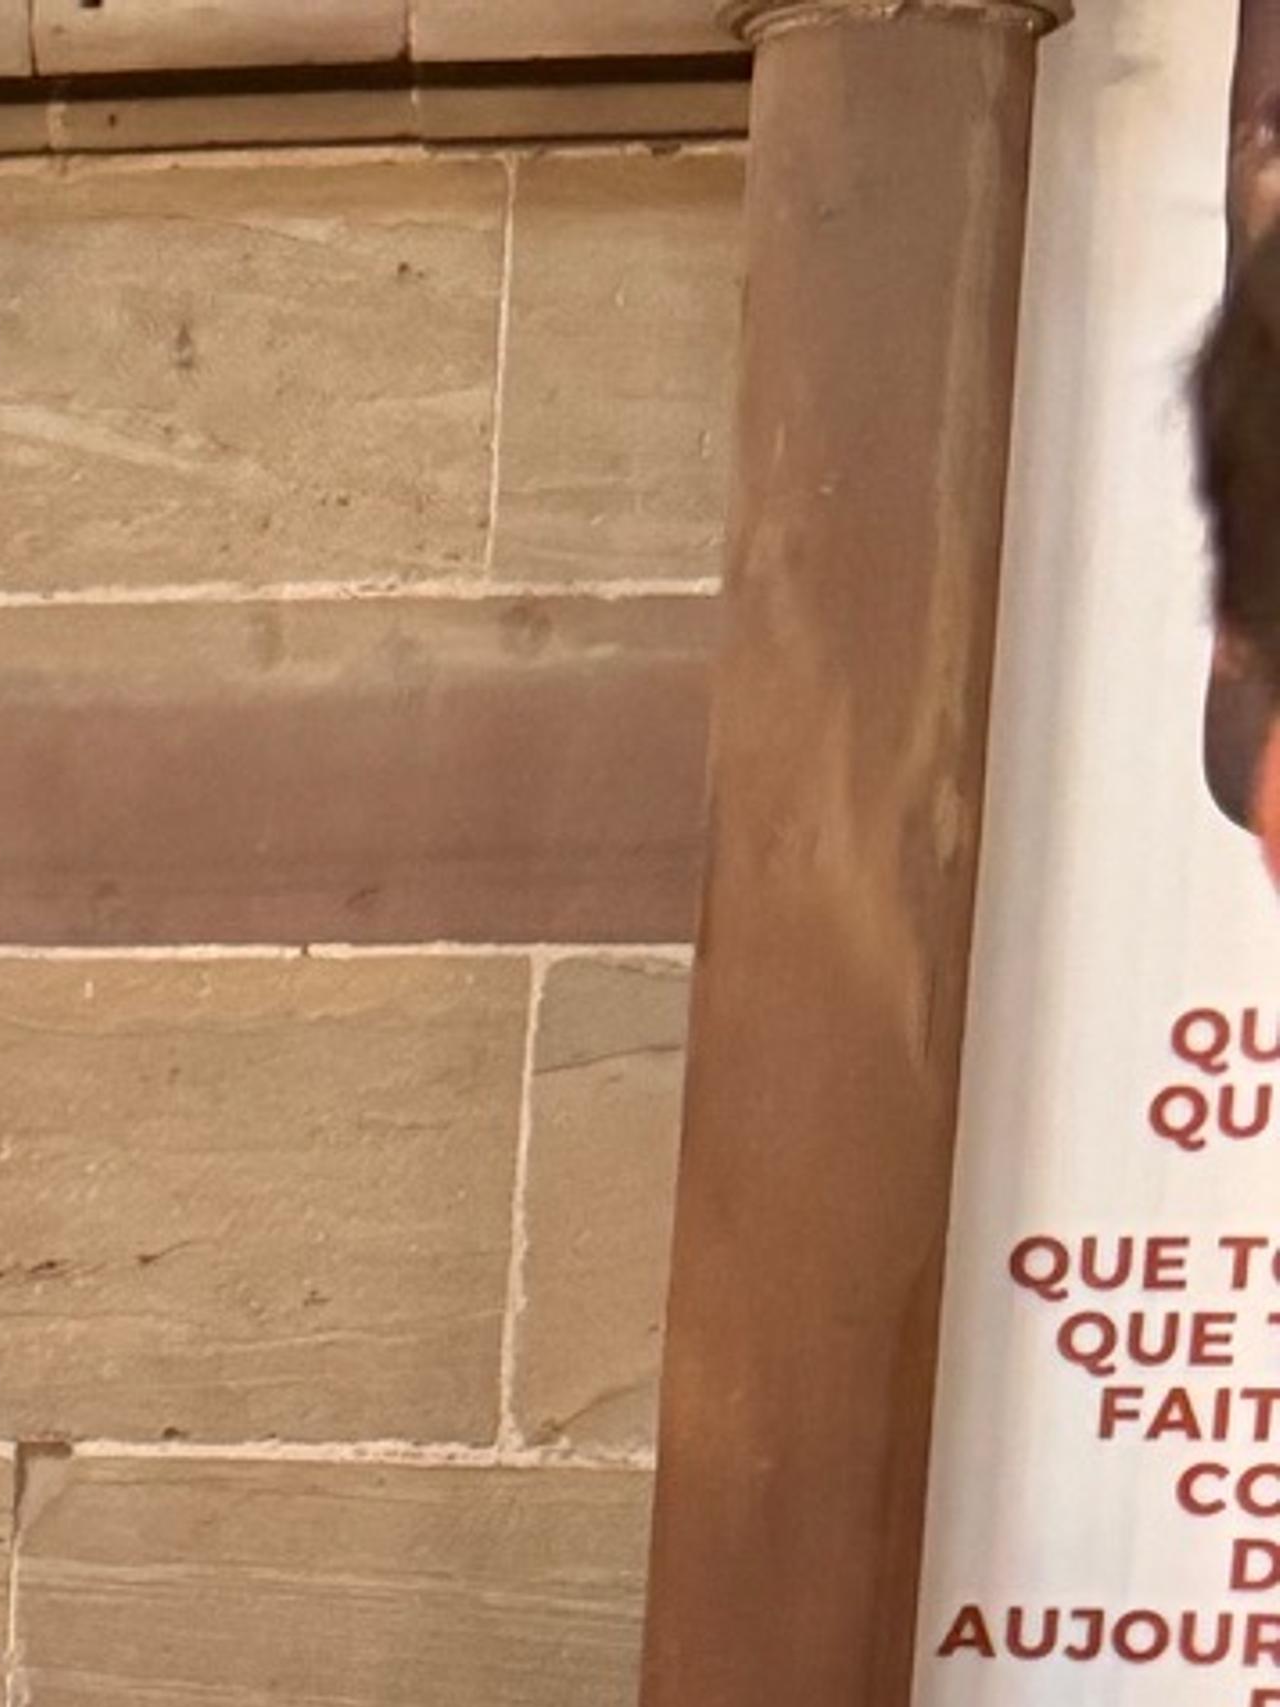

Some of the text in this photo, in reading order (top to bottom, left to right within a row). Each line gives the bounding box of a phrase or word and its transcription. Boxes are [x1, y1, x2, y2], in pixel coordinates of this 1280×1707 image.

[1009, 1234, 1280, 1302] QUE T
[1057, 1311, 1237, 1377] QUE
[1098, 1387, 1280, 1441] FAIT
